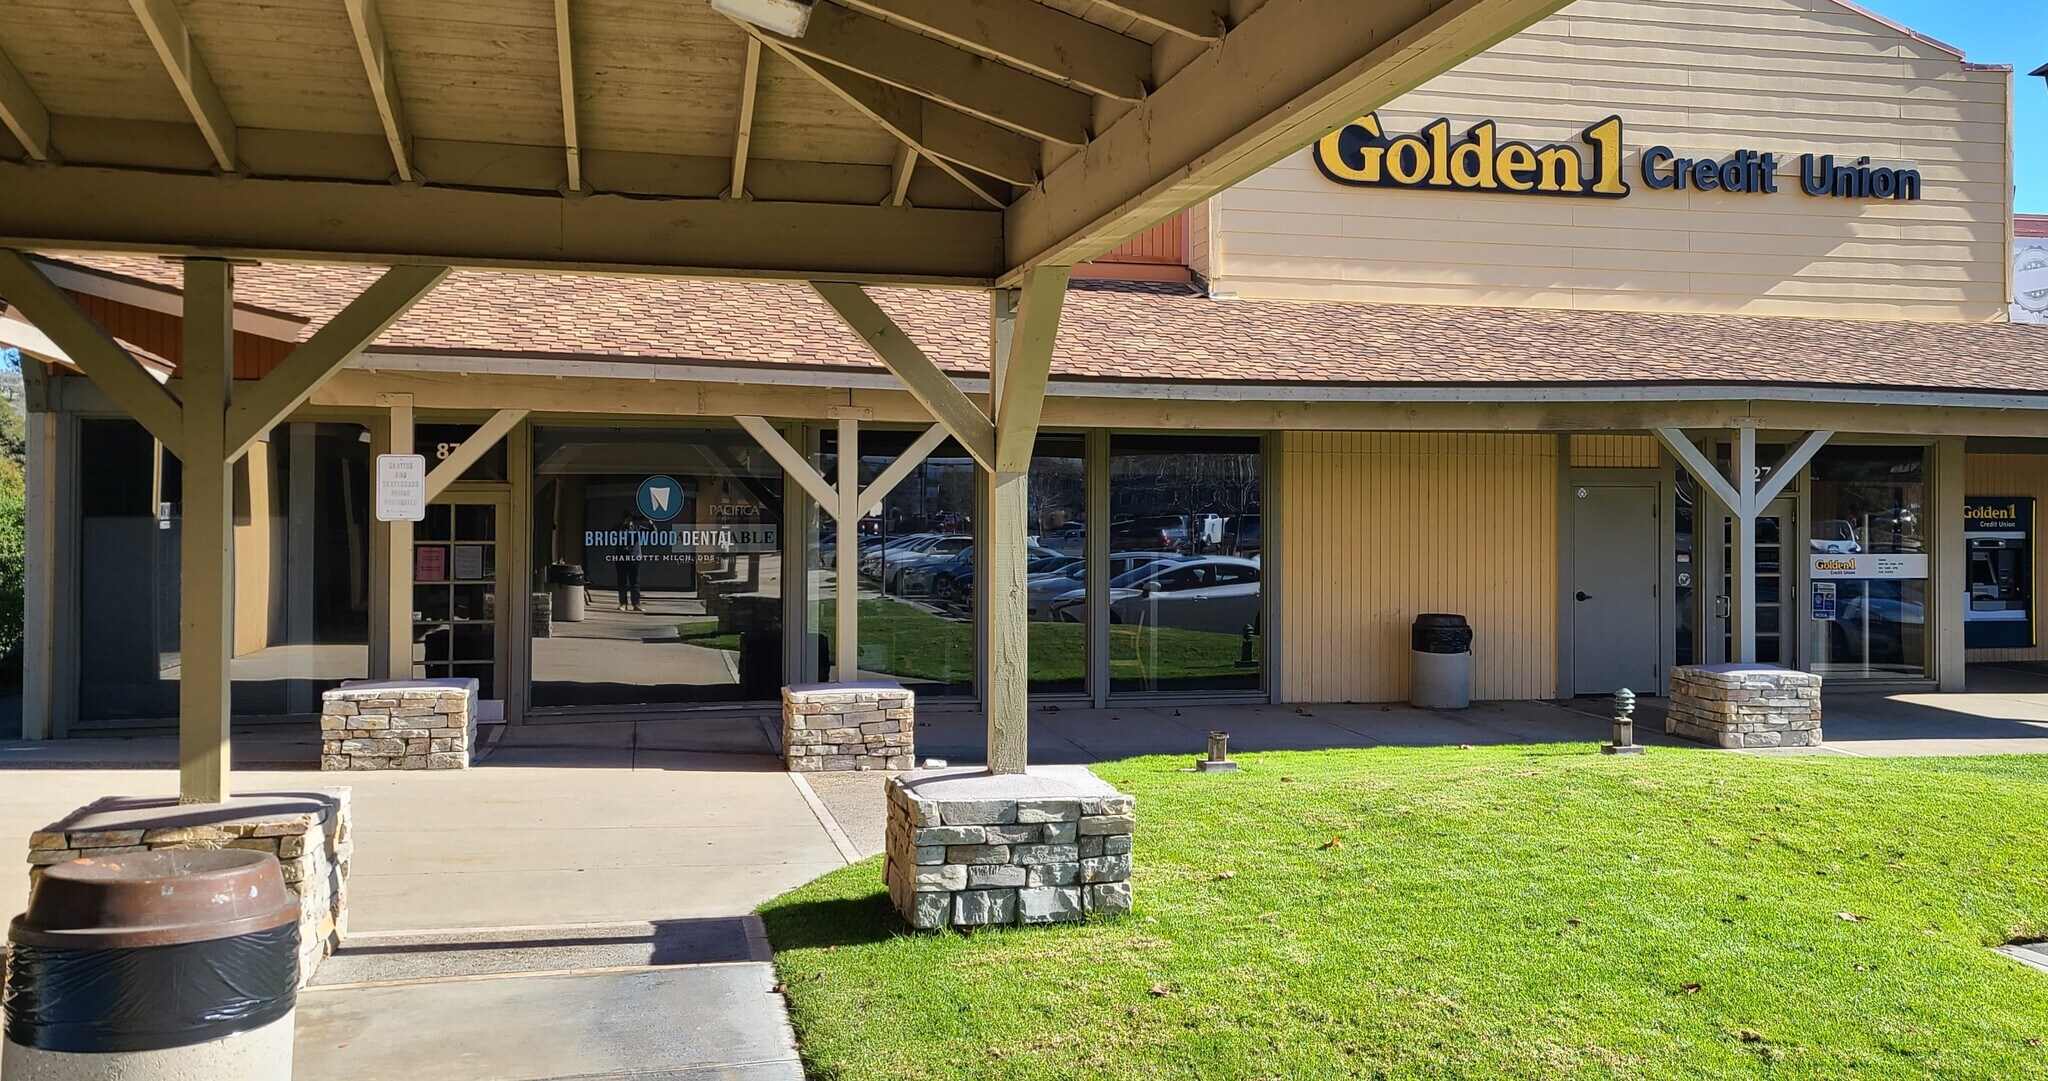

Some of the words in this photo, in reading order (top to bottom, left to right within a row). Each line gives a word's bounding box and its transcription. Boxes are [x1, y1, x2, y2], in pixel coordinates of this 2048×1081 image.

[1640, 146, 1778, 195] Credit
[1800, 153, 1921, 201] Union
[709, 504, 761, 516] PACIFICA
[585, 530, 677, 547] BRIGHTWOOD
[683, 530, 735, 547] DENTAL
[605, 554, 660, 562] CHARLOTTE
